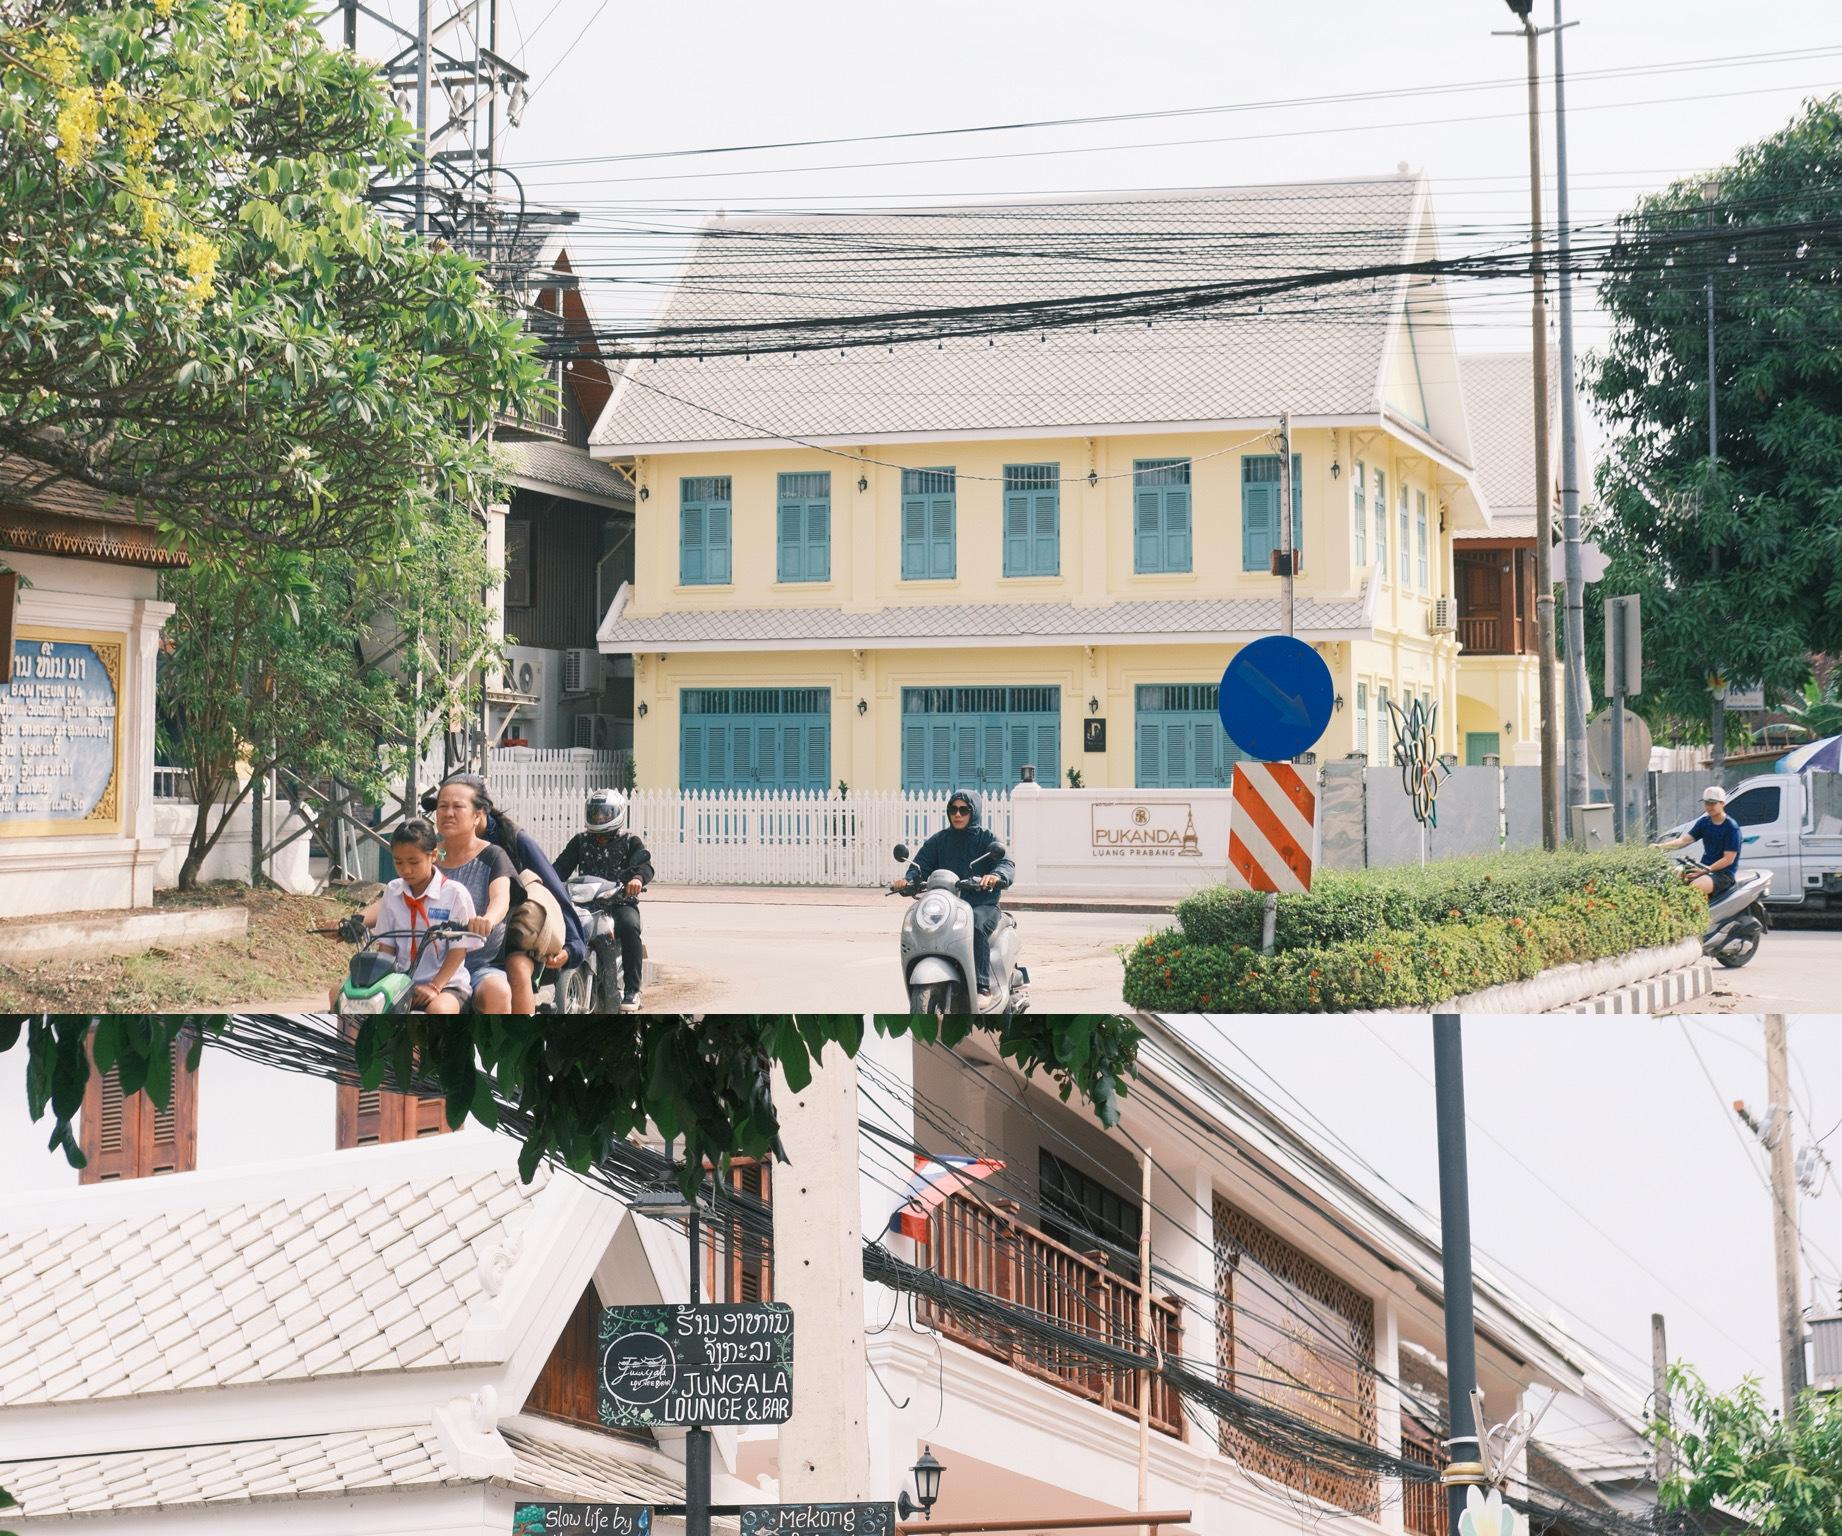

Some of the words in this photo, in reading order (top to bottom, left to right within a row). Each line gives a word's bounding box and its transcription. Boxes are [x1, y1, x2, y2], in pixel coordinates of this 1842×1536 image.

[10, 683, 34, 698] BAN
[36, 684, 65, 699] MEUN
[66, 685, 82, 699] NA
[1095, 829, 1182, 844] PUKANDA
[1092, 849, 1125, 857] LUANG
[1129, 849, 1175, 857] PRABANG
[681, 1371, 788, 1398] JUNGALA
[664, 1397, 741, 1422] LOUNGE
[585, 1505, 608, 1534] life
[613, 1507, 632, 1535] by
[779, 1505, 856, 1532] Mekong
